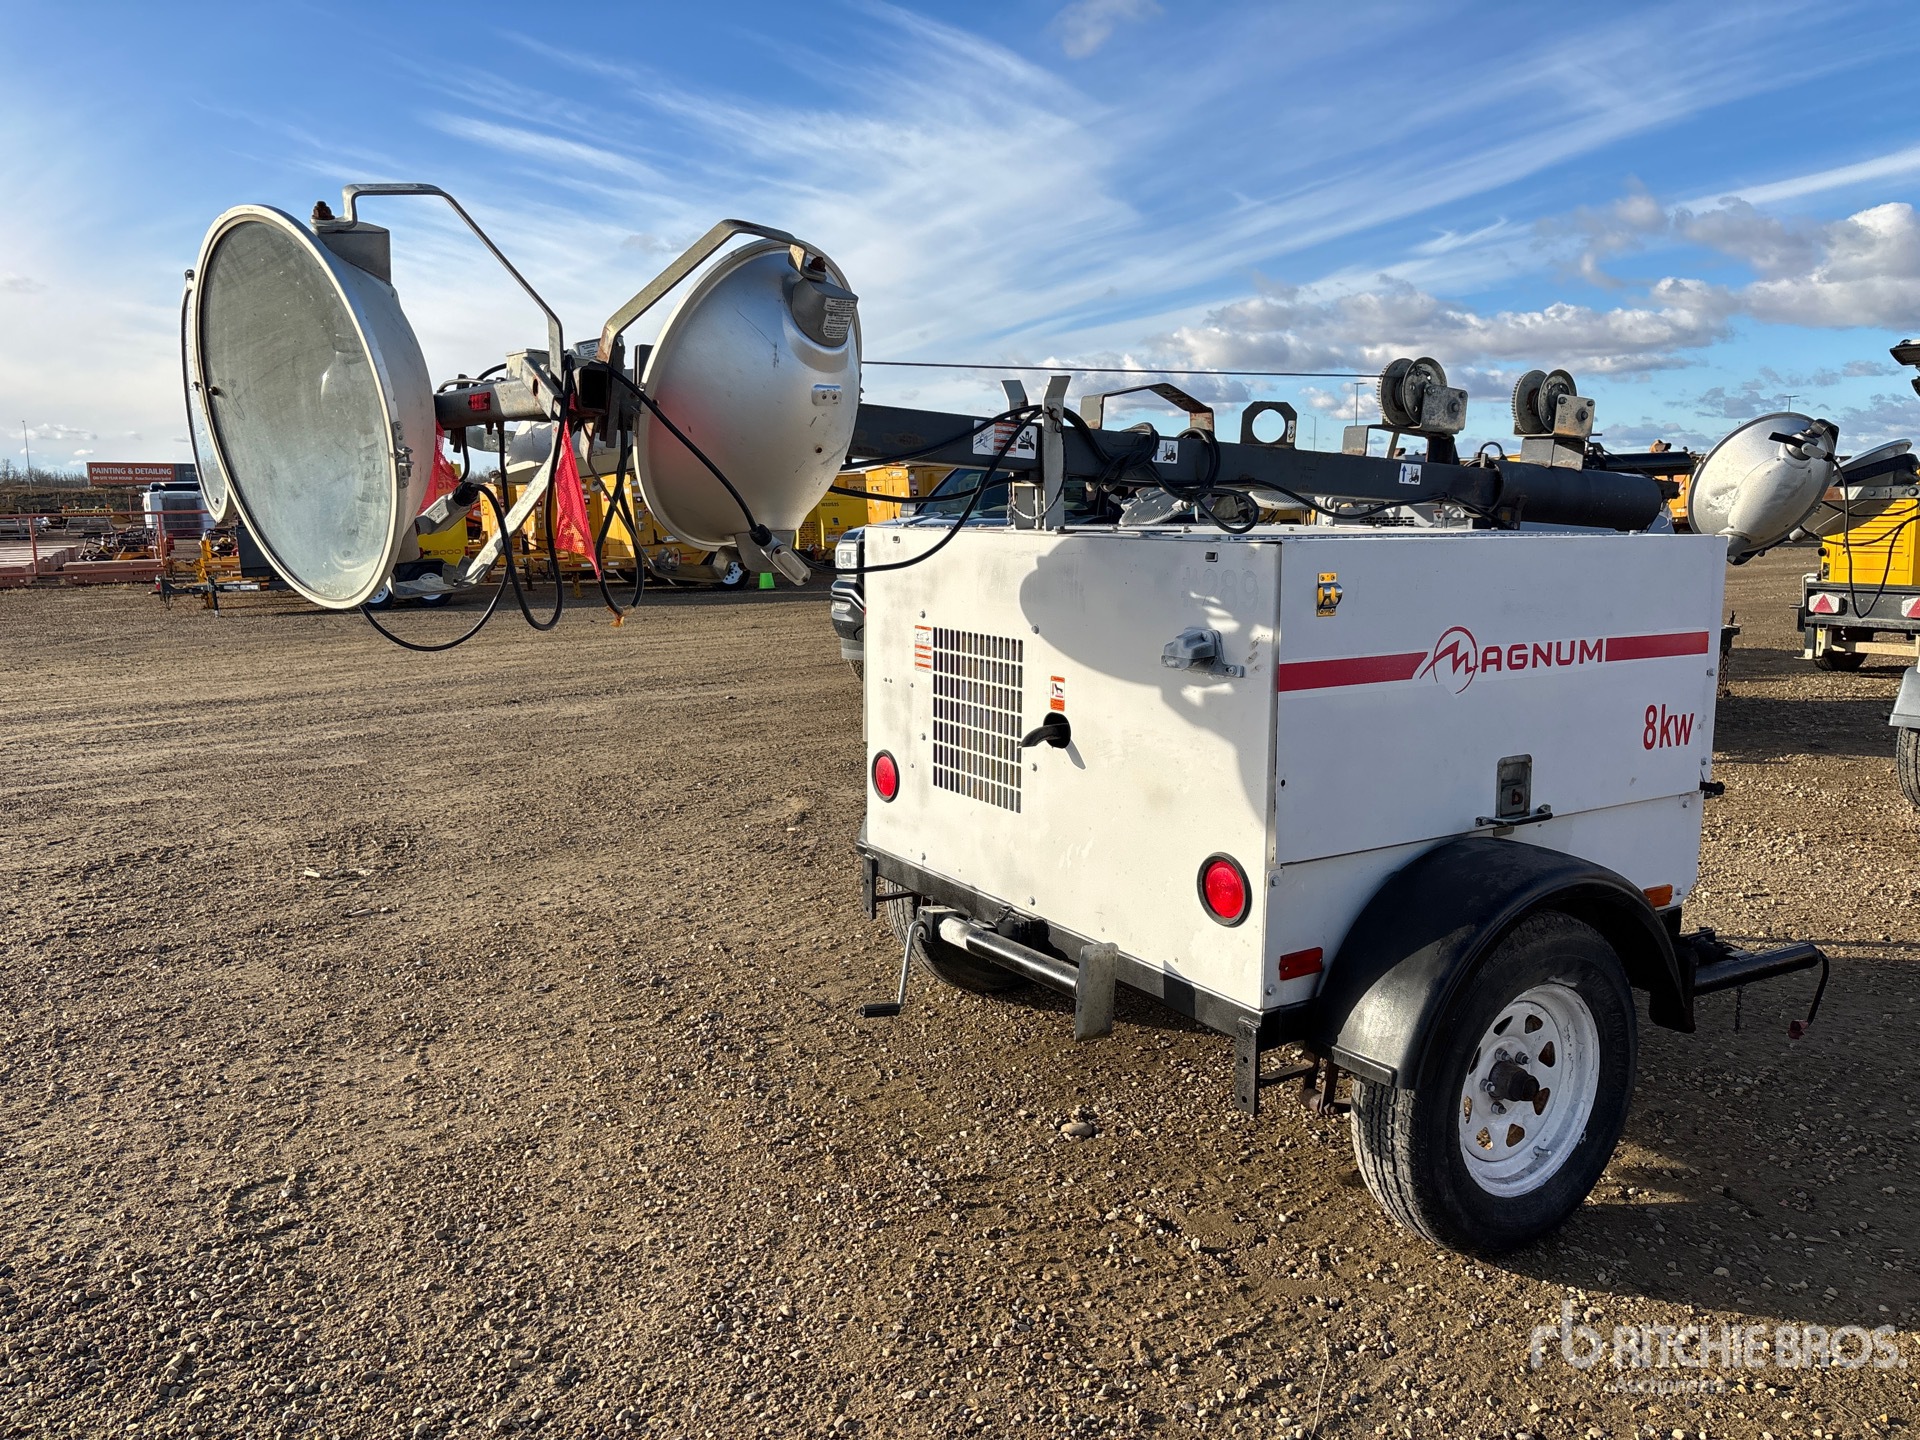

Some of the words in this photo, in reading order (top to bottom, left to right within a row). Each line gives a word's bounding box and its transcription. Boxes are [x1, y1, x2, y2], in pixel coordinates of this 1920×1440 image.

[91, 467, 126, 475] PAINTING
[127, 467, 134, 475] &
[135, 467, 172, 475] DETAILING
[1419, 635, 1604, 682] MAGNUM
